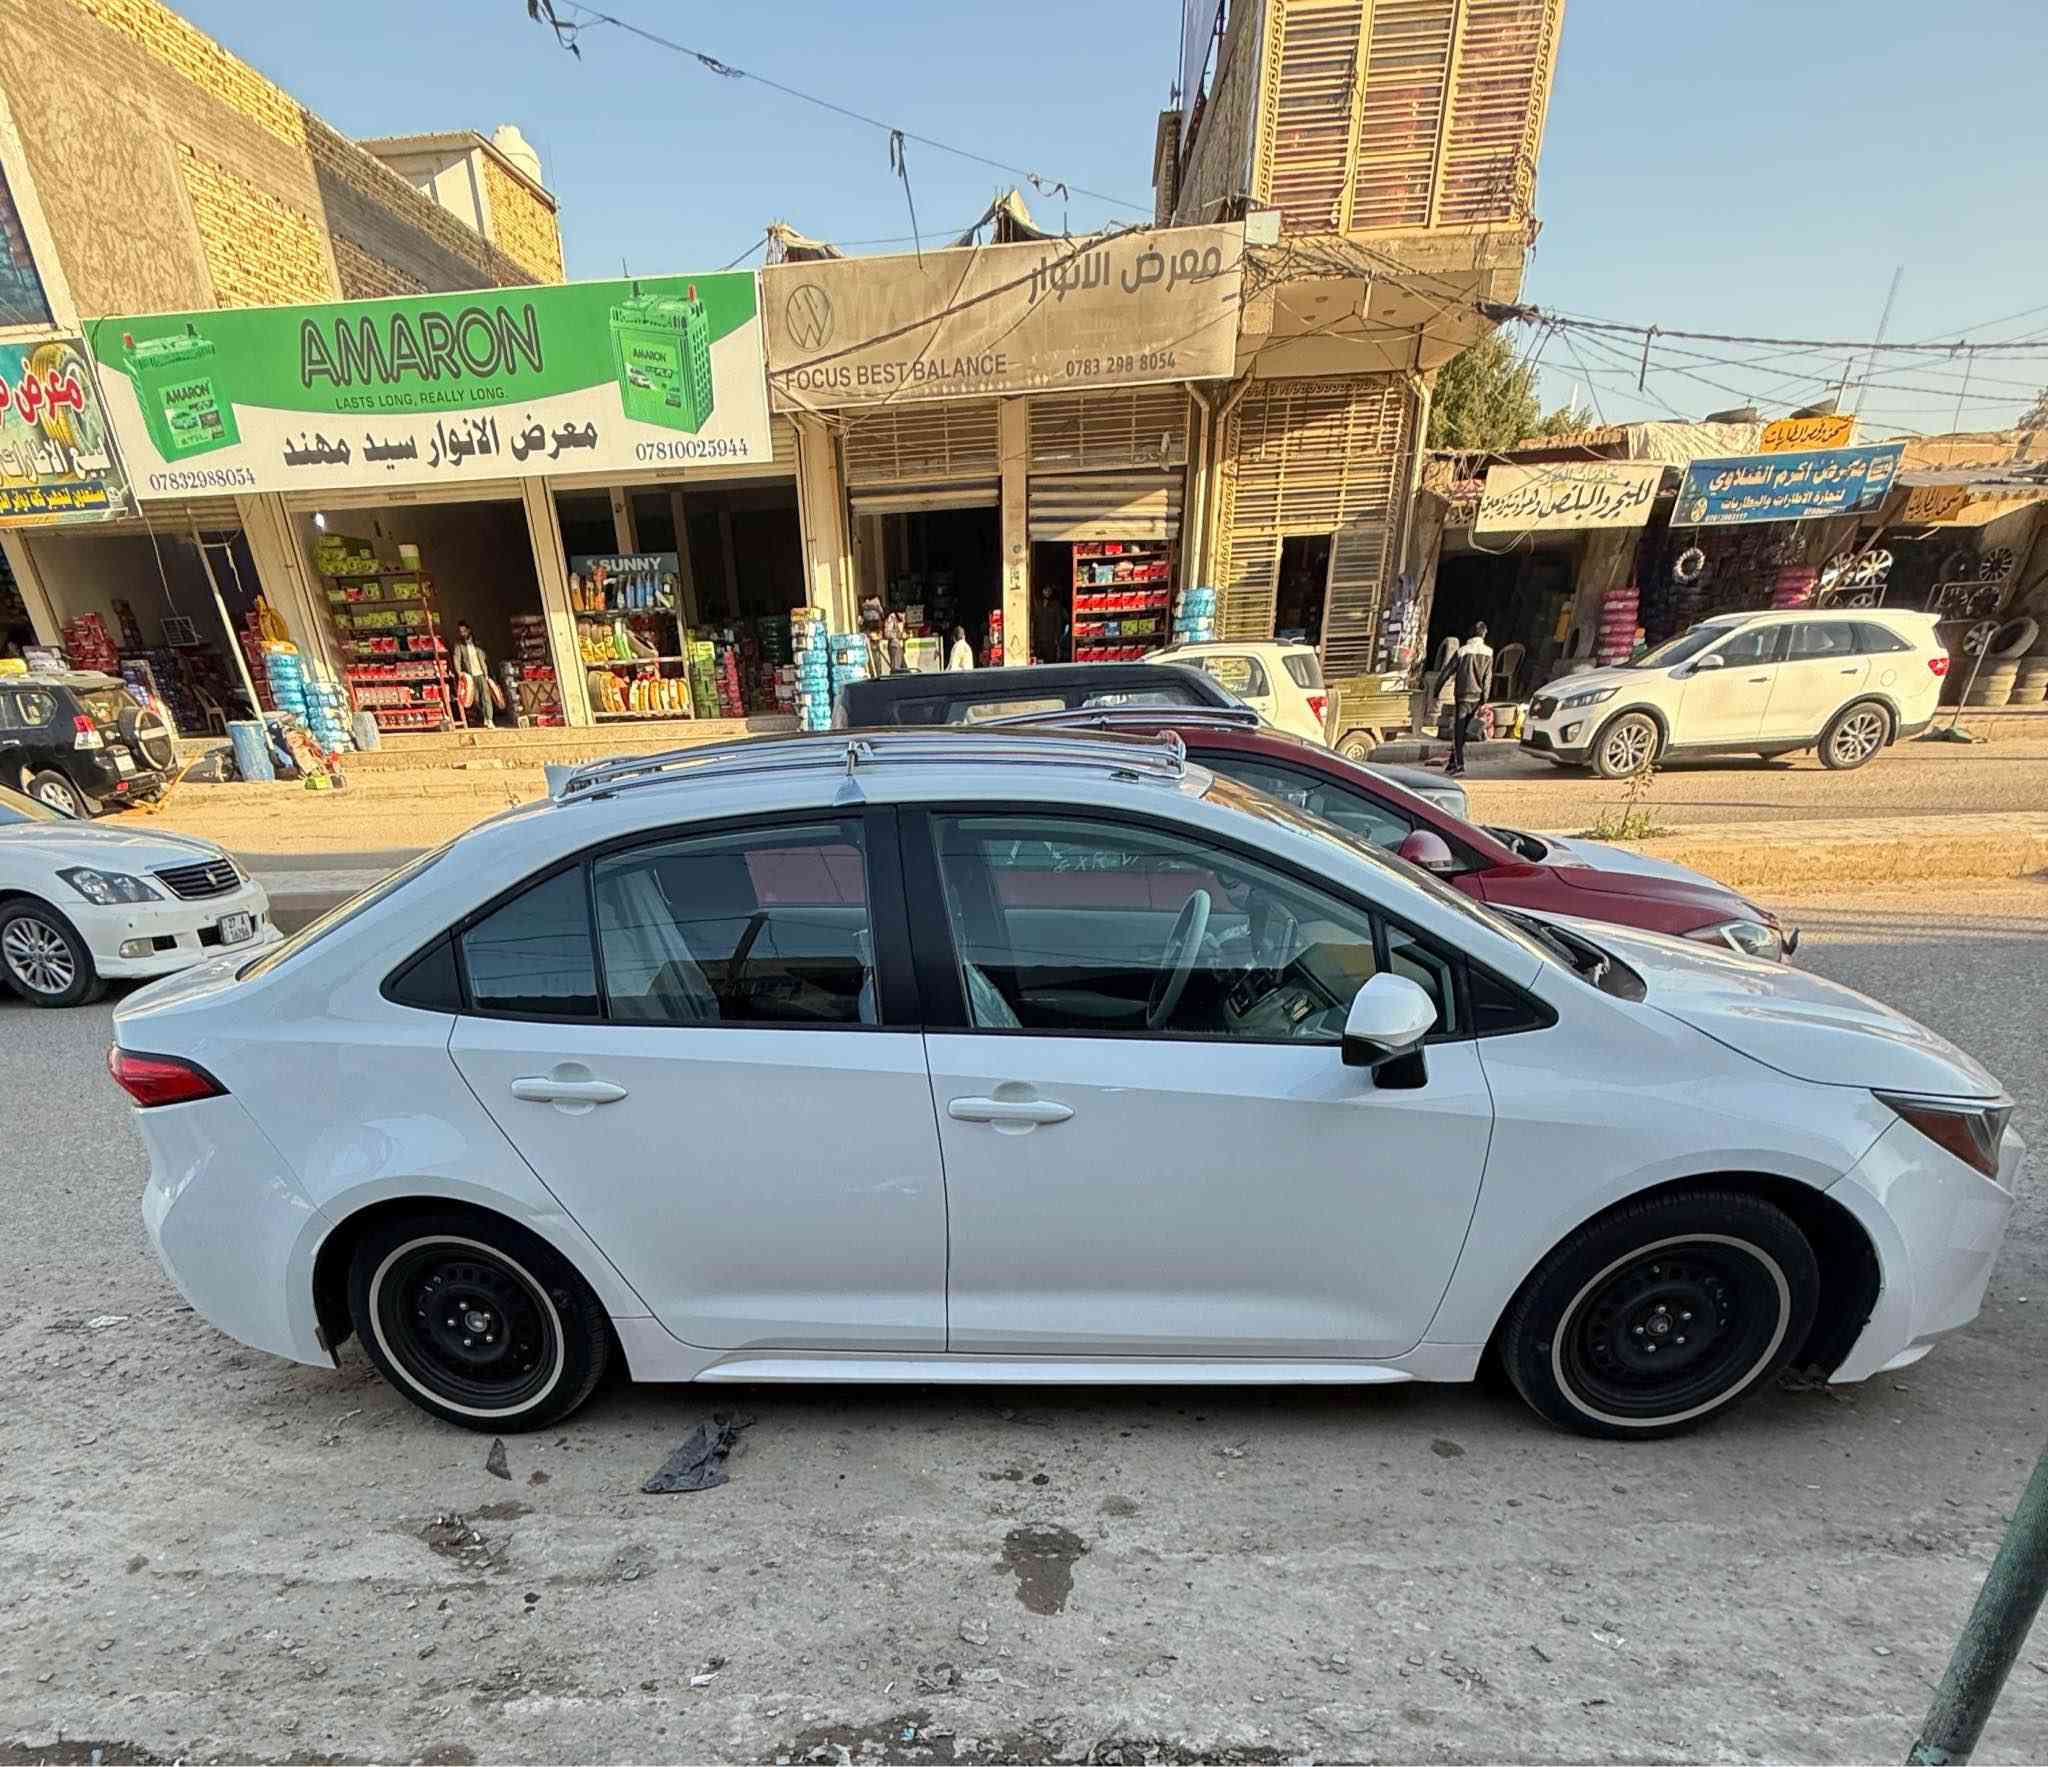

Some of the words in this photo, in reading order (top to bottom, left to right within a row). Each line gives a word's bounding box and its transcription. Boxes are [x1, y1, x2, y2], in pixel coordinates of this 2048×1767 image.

[1121, 243, 1222, 294] معرض
[301, 303, 544, 389] AMARON
[1066, 358, 1100, 377] 0783
[1106, 354, 1134, 373] 298
[1139, 351, 1177, 370] 8054
[785, 365, 851, 391] FOCUS
[856, 362, 909, 385] BEST
[912, 353, 1008, 381] BALANCE
[13, 358, 85, 427] معرض
[335, 397, 375, 410] LASTS
[379, 393, 418, 408] LONG,
[421, 389, 465, 404] REALLY
[284, 432, 351, 467] مهند
[362, 432, 418, 470] سيد
[427, 415, 500, 468] الانوار
[511, 413, 598, 462] معرض
[636, 438, 748, 461] 07810025944
[149, 467, 256, 491] 07832988054
[600, 557, 661, 571] SUNNY
